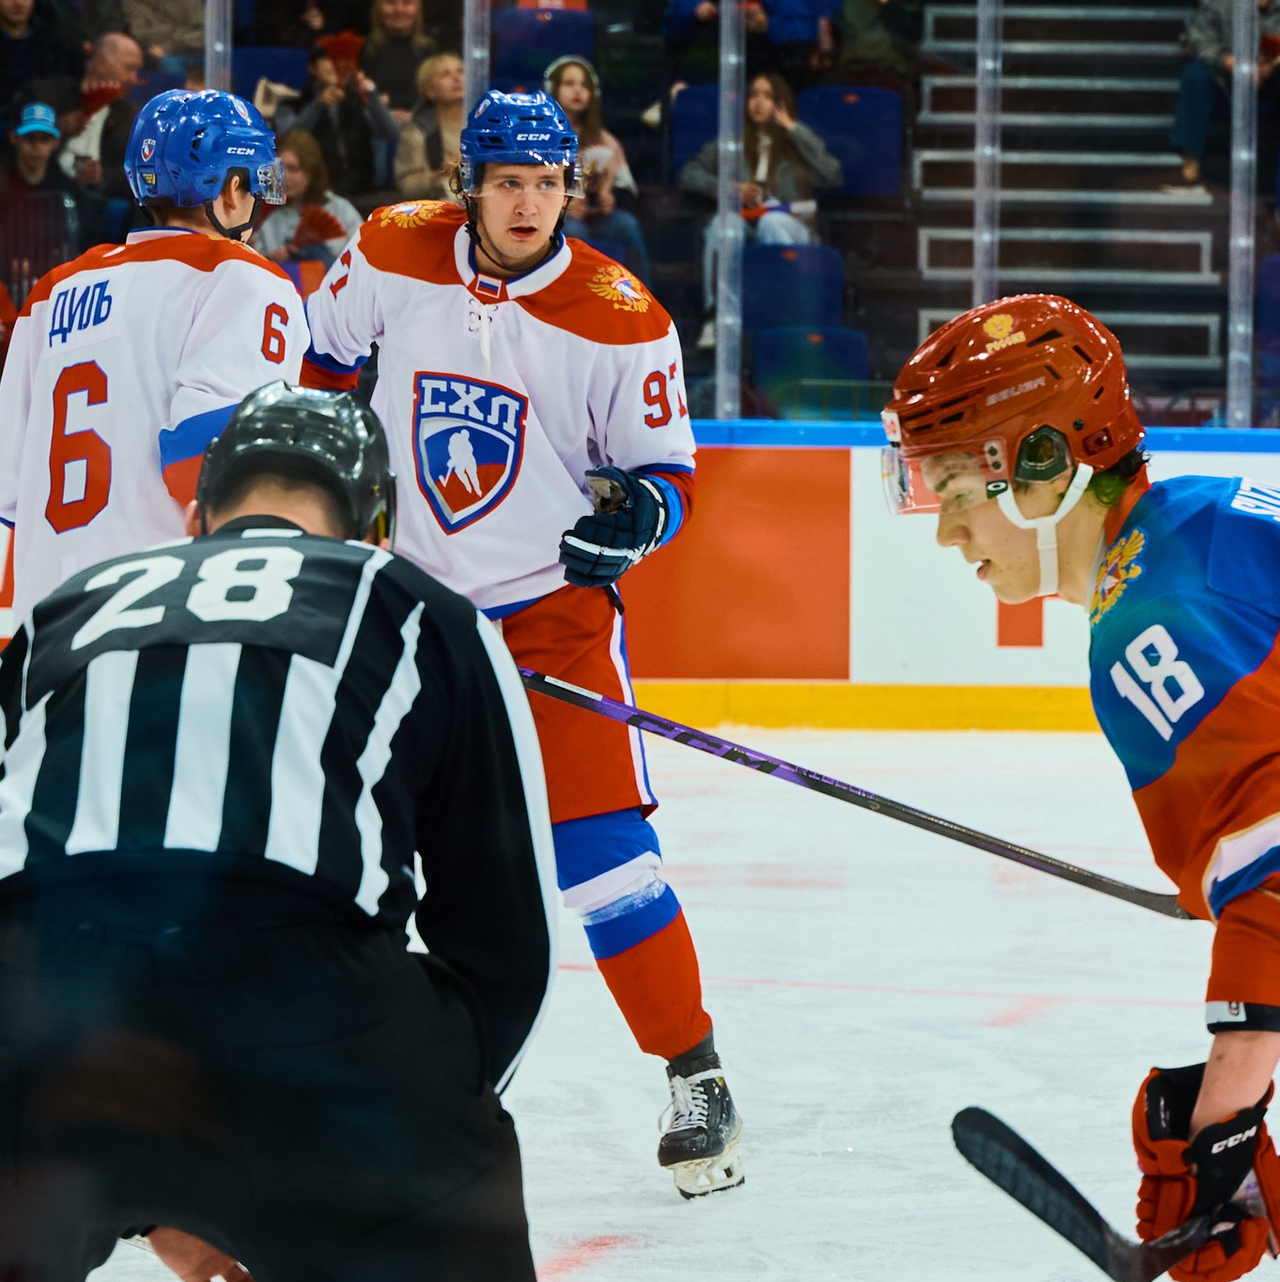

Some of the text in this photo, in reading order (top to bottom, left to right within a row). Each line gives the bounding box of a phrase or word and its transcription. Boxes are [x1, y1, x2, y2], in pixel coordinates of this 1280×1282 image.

[226, 146, 256, 156] CCM
[516, 133, 551, 142] CCM
[49, 279, 113, 348] ДИЛЬ
[261, 301, 290, 365] 6
[45, 359, 112, 535] 6
[71, 547, 305, 651] 28
[1110, 623, 1205, 742] 18
[625, 713, 780, 775] CCM
[1210, 1125, 1258, 1155] CCM
